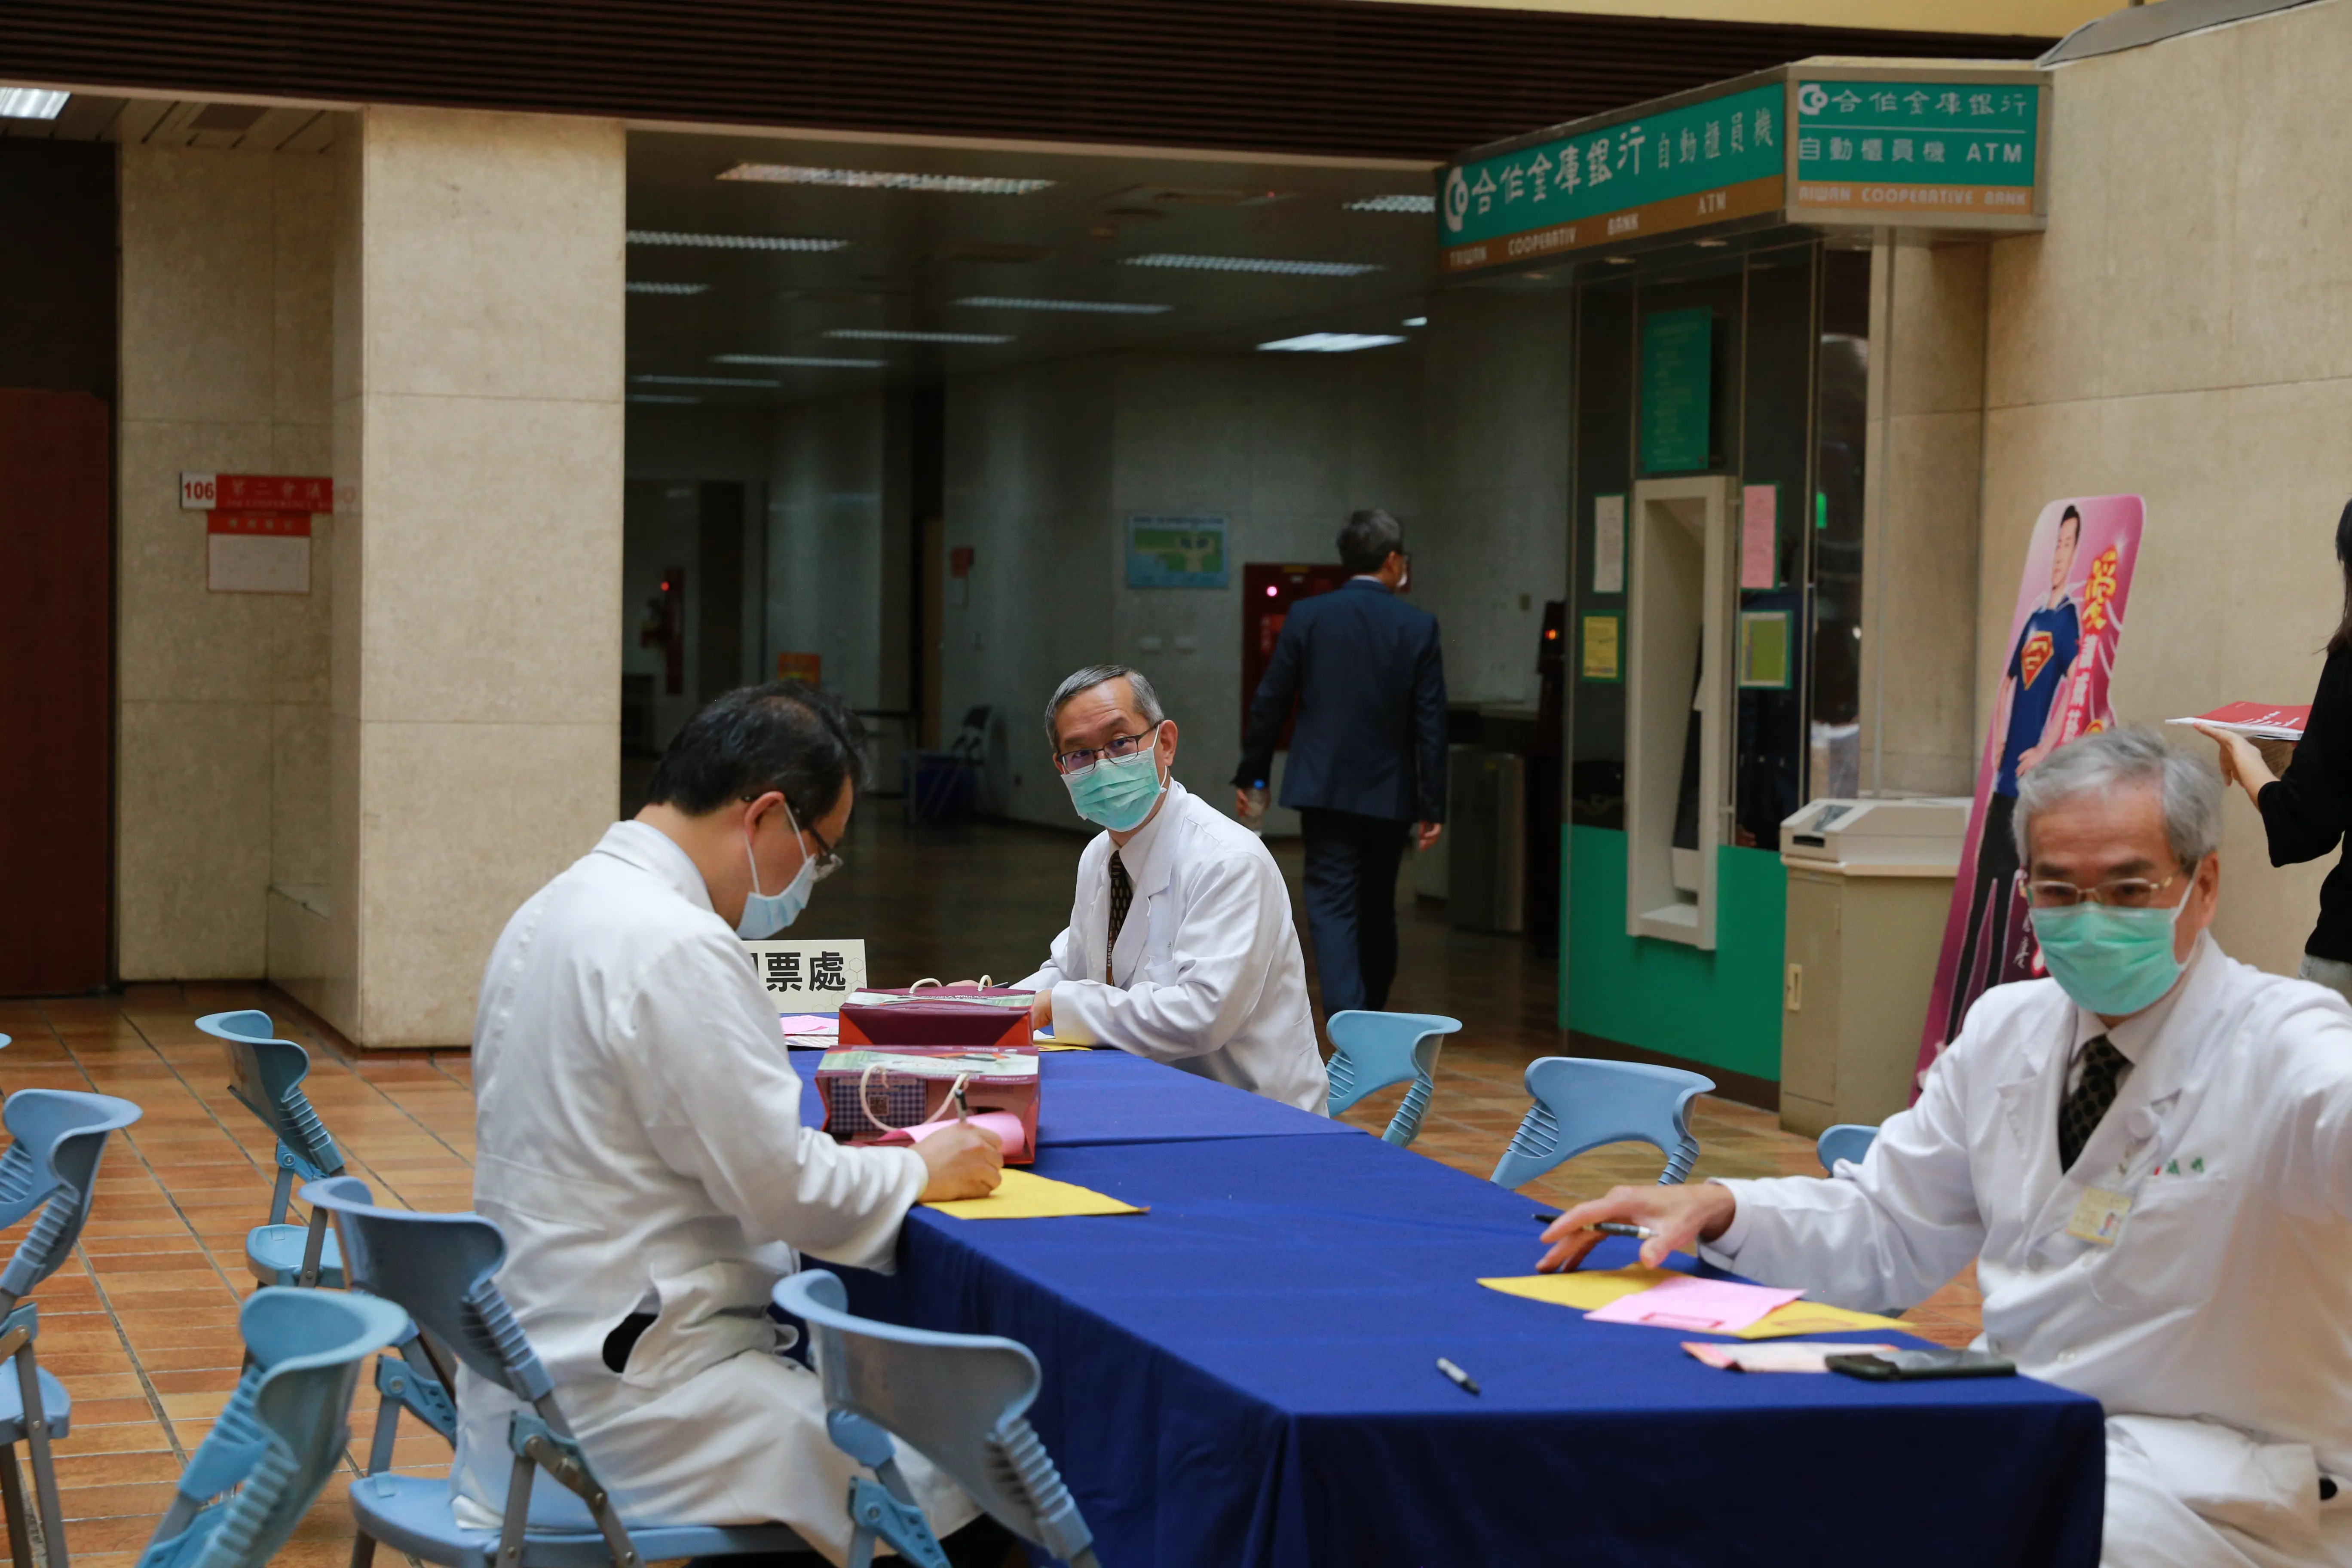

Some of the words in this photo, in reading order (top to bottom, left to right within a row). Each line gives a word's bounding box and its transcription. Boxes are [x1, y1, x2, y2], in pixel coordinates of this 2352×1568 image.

[1831, 89, 2027, 116] 合作金庫銀行
[1471, 126, 1646, 214] 合作金庫銀行
[1658, 107, 1773, 169] 自動櫃員機
[1798, 137, 1945, 162] 自動櫃員機
[1966, 143, 2022, 163] ATM
[1697, 192, 1726, 214] ATM
[1862, 187, 1973, 205] COOPERATIVE
[1984, 191, 2026, 205] BANK
[184, 481, 214, 500] 106
[750, 951, 846, 992] 票處
